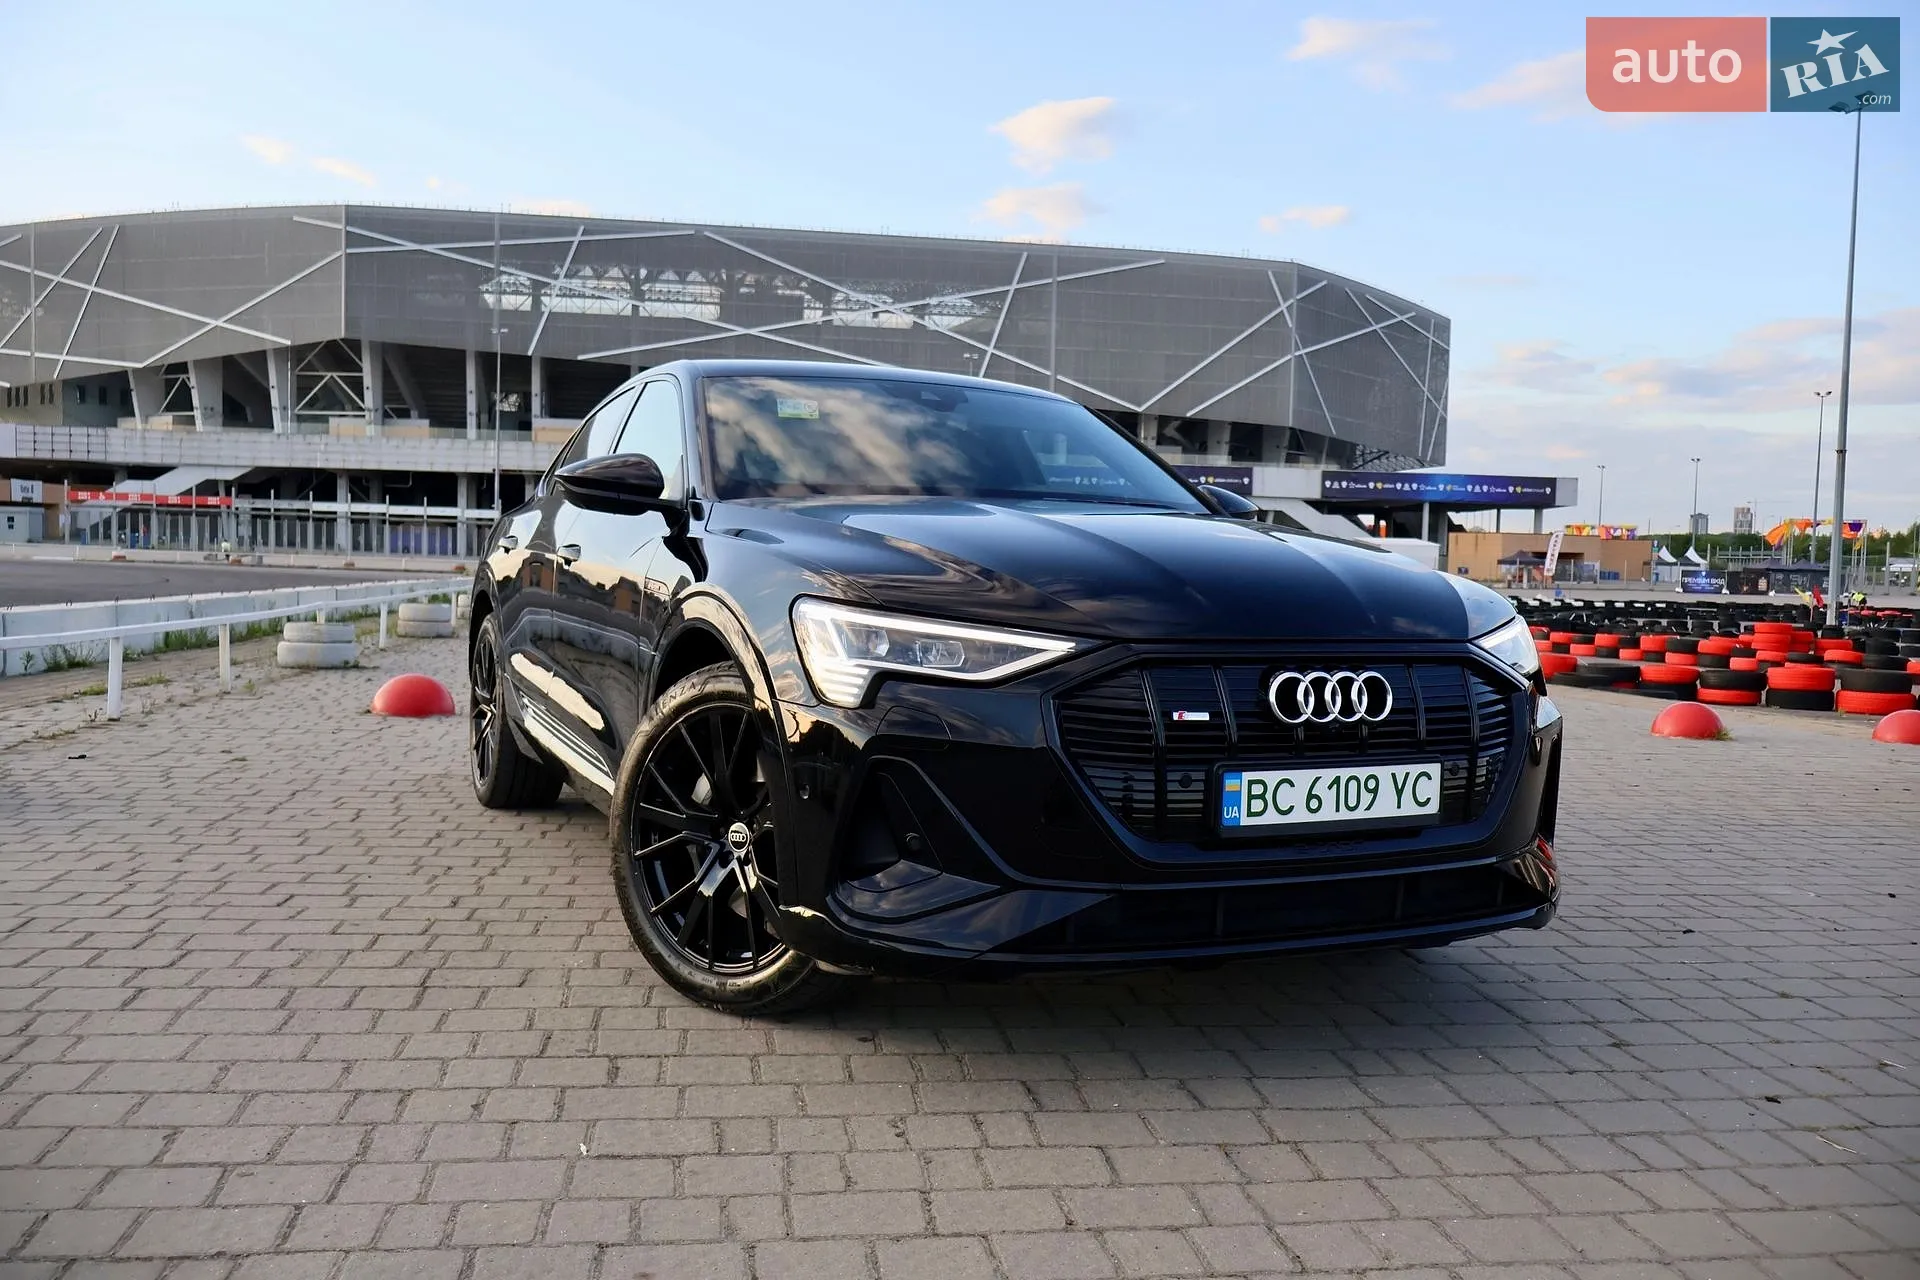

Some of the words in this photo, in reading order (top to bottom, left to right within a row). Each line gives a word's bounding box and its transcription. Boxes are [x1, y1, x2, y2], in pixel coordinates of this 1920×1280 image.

[1246, 777, 1296, 818] BC
[1305, 773, 1380, 814] 6109
[1391, 770, 1433, 809] YC
[1223, 806, 1239, 818] UA
